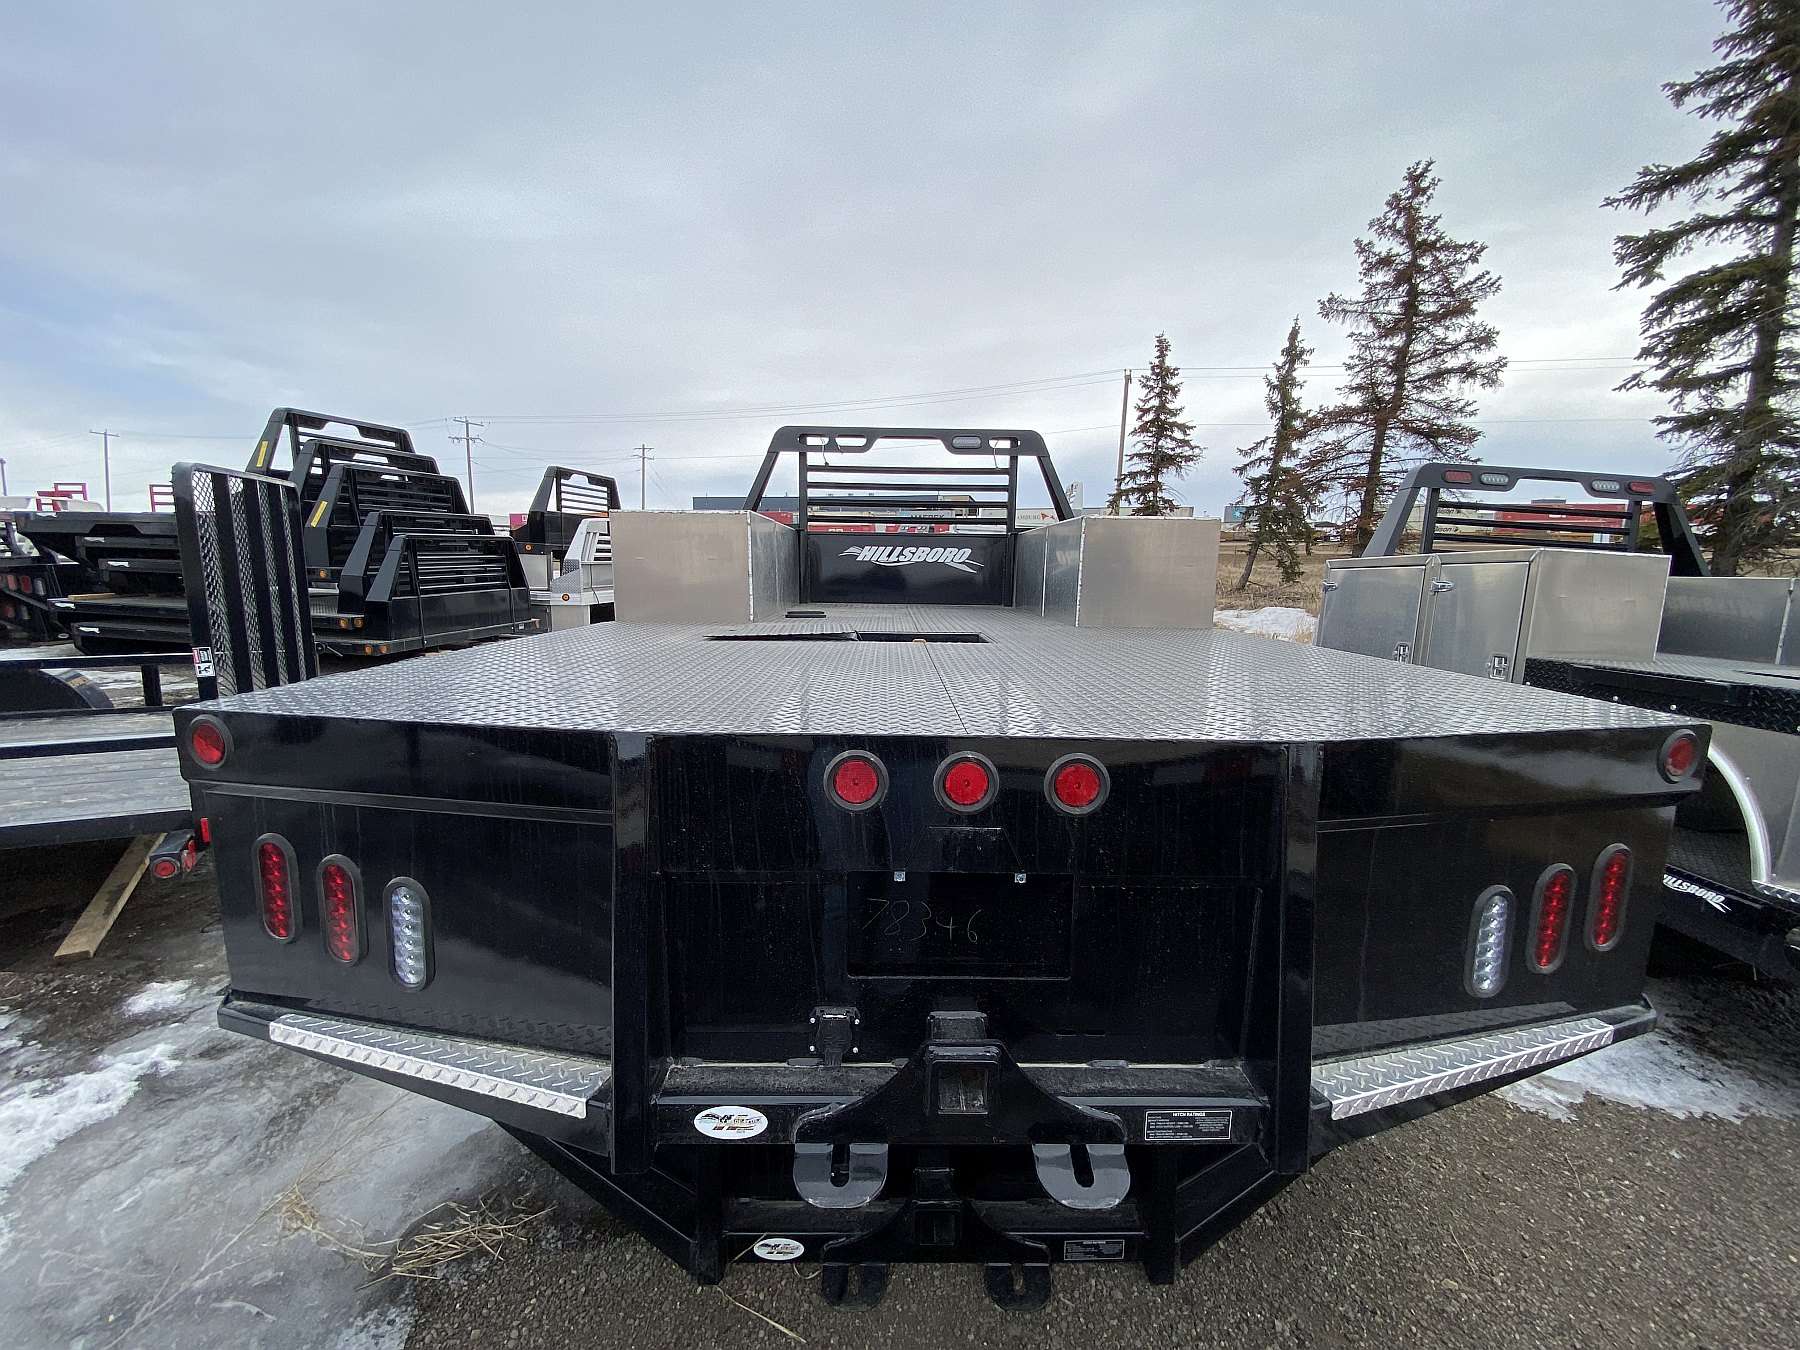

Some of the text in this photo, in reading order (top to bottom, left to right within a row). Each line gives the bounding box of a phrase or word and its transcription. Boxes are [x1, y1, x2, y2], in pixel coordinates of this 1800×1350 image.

[855, 545, 973, 564] HILLSBORO
[1663, 874, 1726, 904] ILLSBORO
[861, 897, 983, 943] 78346
